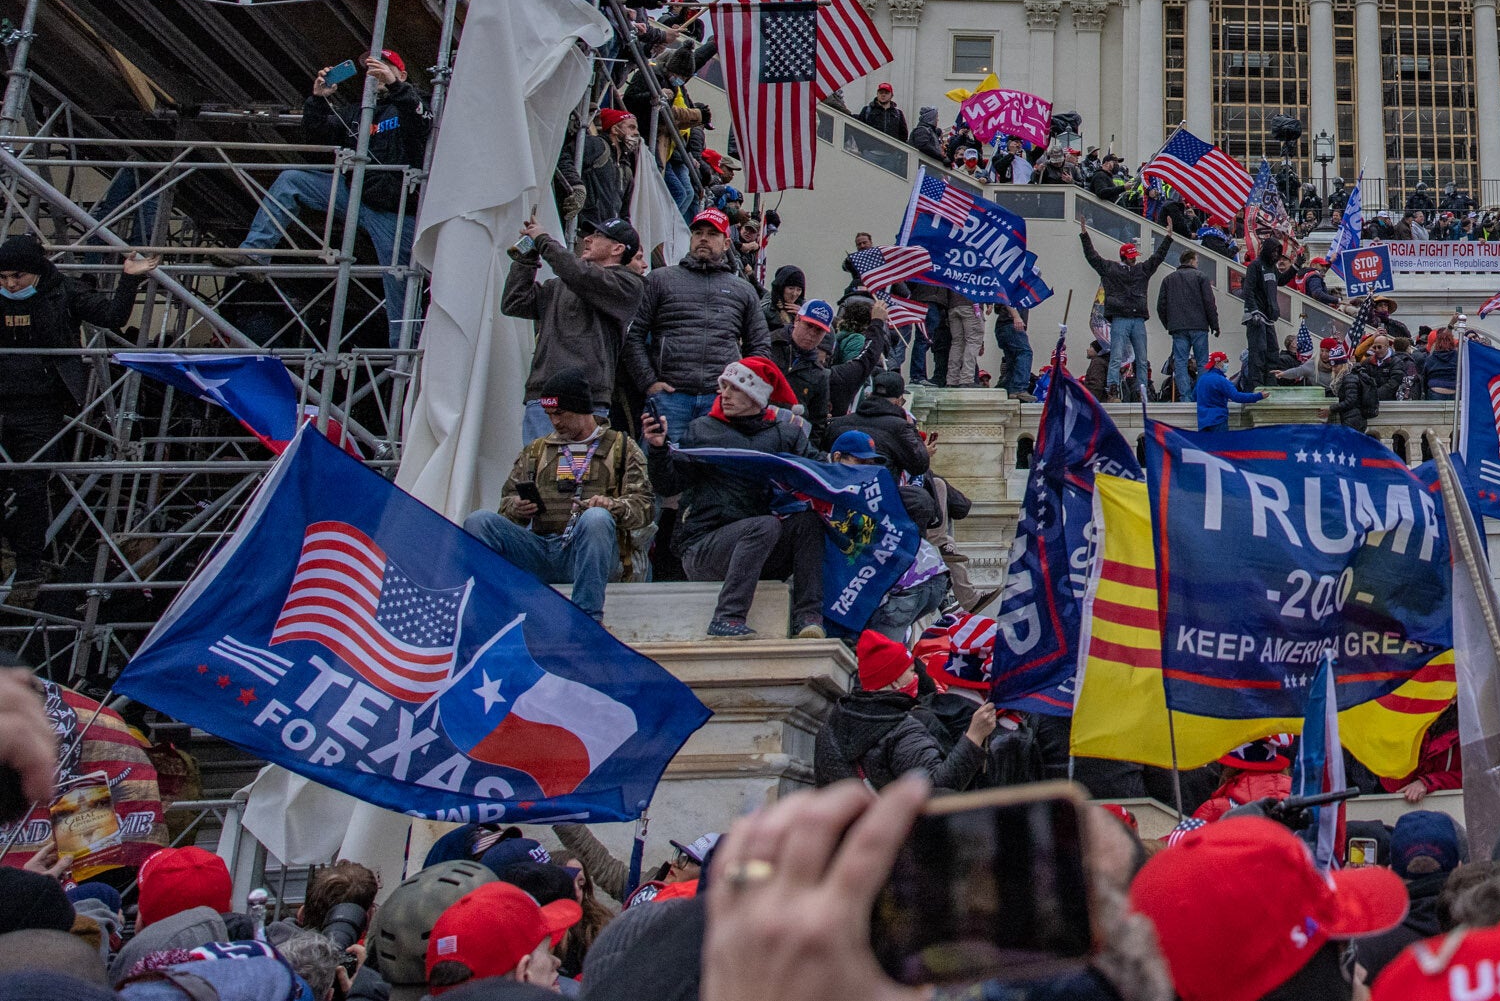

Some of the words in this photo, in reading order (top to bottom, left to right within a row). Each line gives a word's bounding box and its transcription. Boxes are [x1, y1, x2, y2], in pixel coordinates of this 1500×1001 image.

[1419, 243, 1450, 258] FIGHT
[1452, 243, 1475, 257] FOR
[1353, 255, 1379, 271] STOP
[1453, 258, 1499, 269] Republicans
[943, 267, 1001, 288] AMERICA
[1358, 270, 1378, 280] THE
[1350, 279, 1391, 295] STEAL
[1181, 448, 1440, 562] TRUMP
[1176, 624, 1255, 663] KEEP
[1259, 637, 1340, 664] AMERICA
[253, 698, 346, 767] FOR
[295, 654, 516, 800] TEXAS
[64, 810, 97, 828] GREAT
